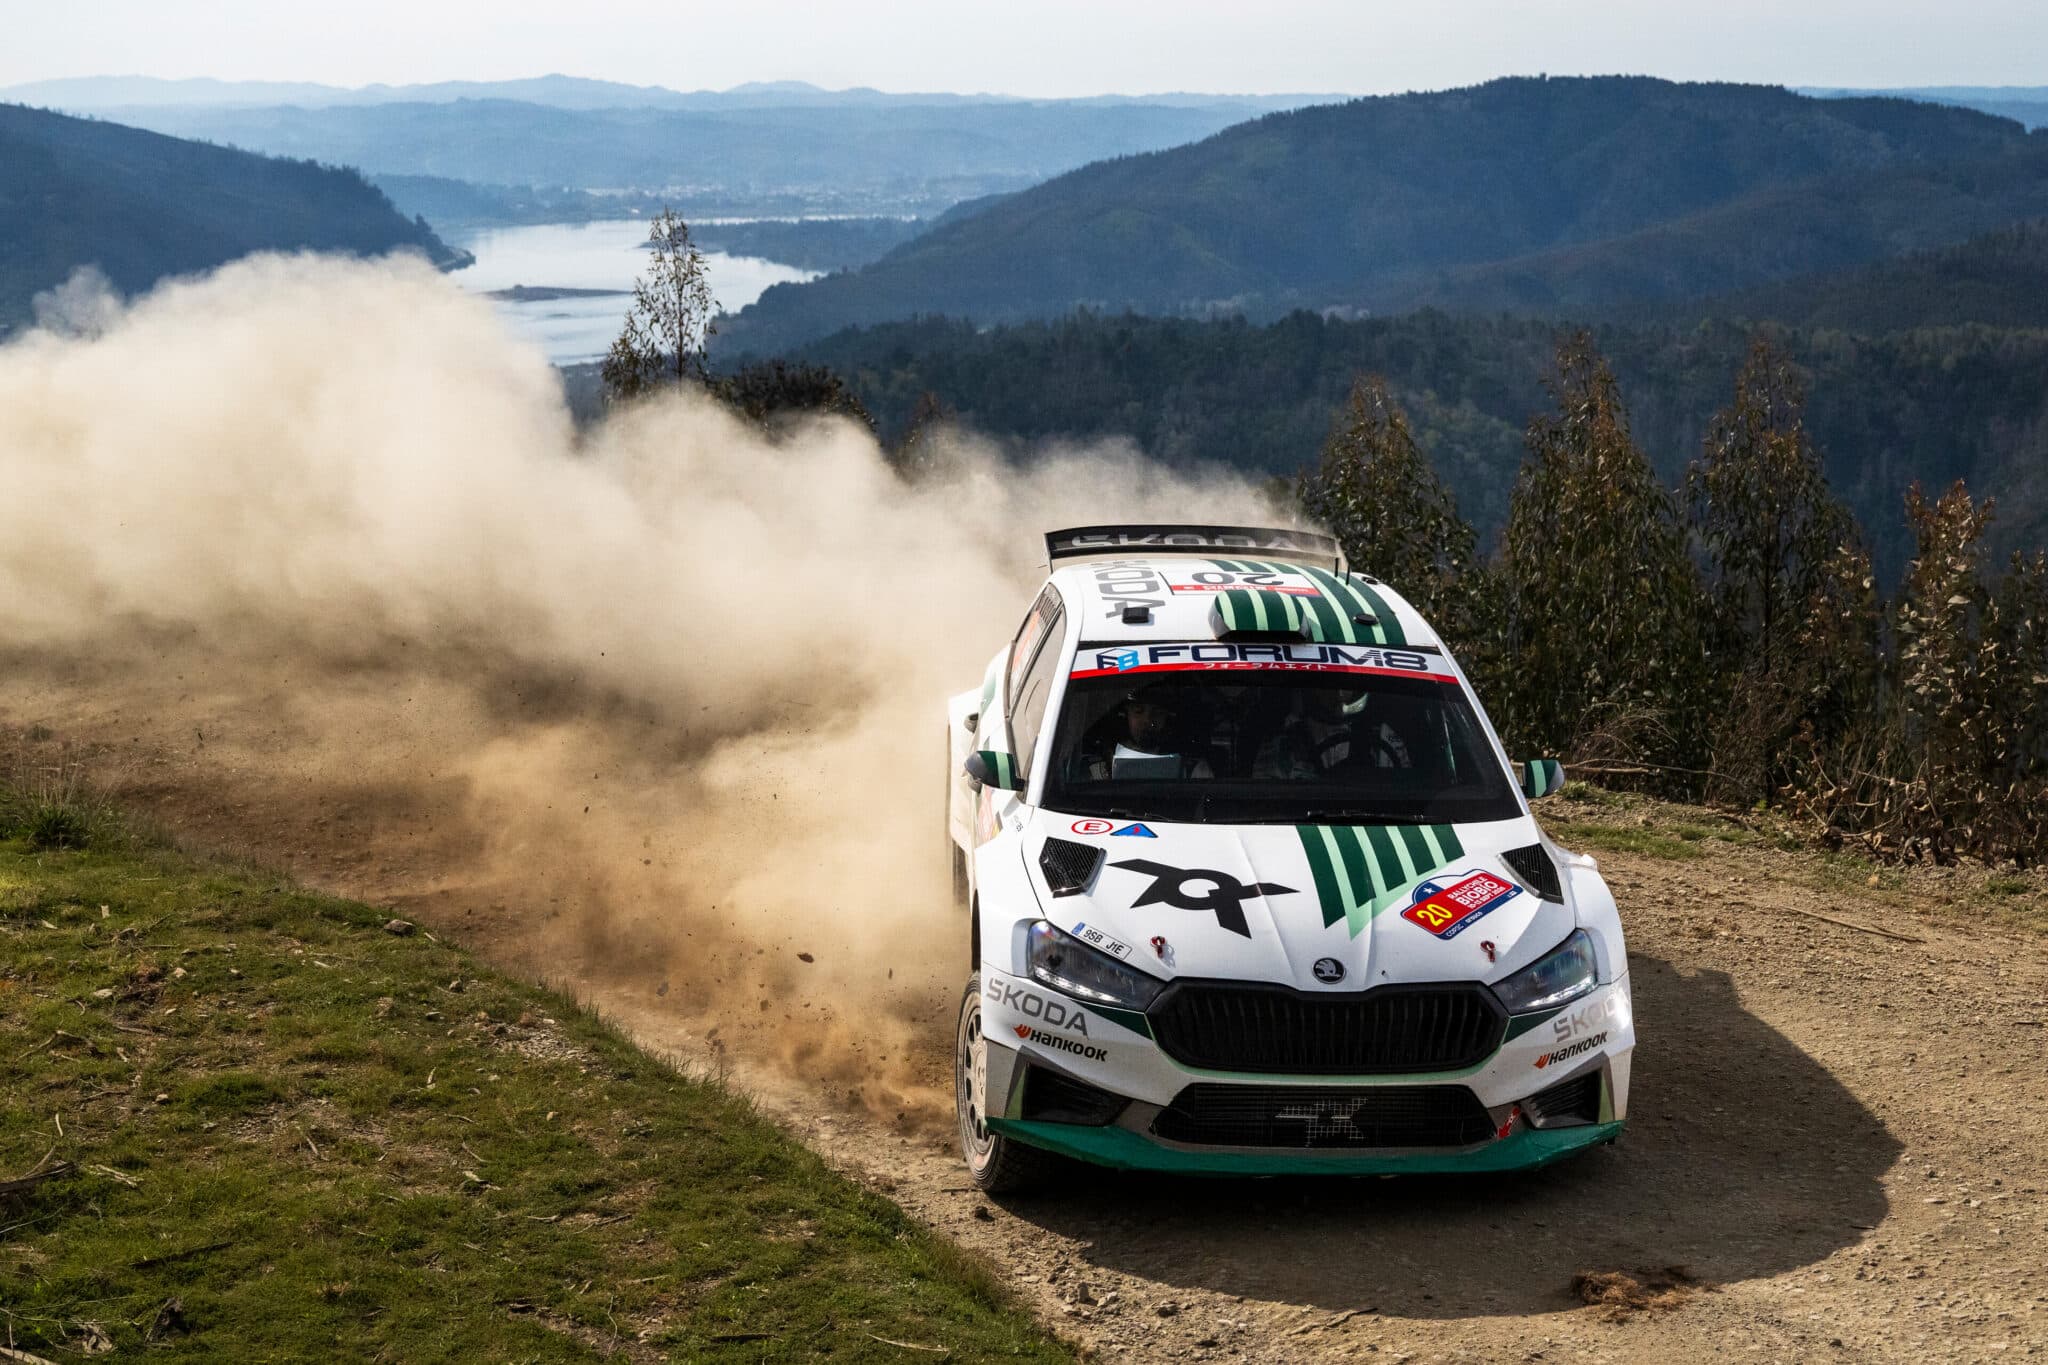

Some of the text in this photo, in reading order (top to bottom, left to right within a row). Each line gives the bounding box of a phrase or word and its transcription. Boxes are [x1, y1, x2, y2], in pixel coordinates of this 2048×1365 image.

[1191, 571, 1284, 586] 20
[1148, 644, 1429, 671] FORUM8
[1203, 662, 1328, 671] フォーラムエイト
[1455, 881, 1499, 905] BIOBIO
[1416, 903, 1453, 927] 20
[1083, 929, 1124, 955] 9SB J1E
